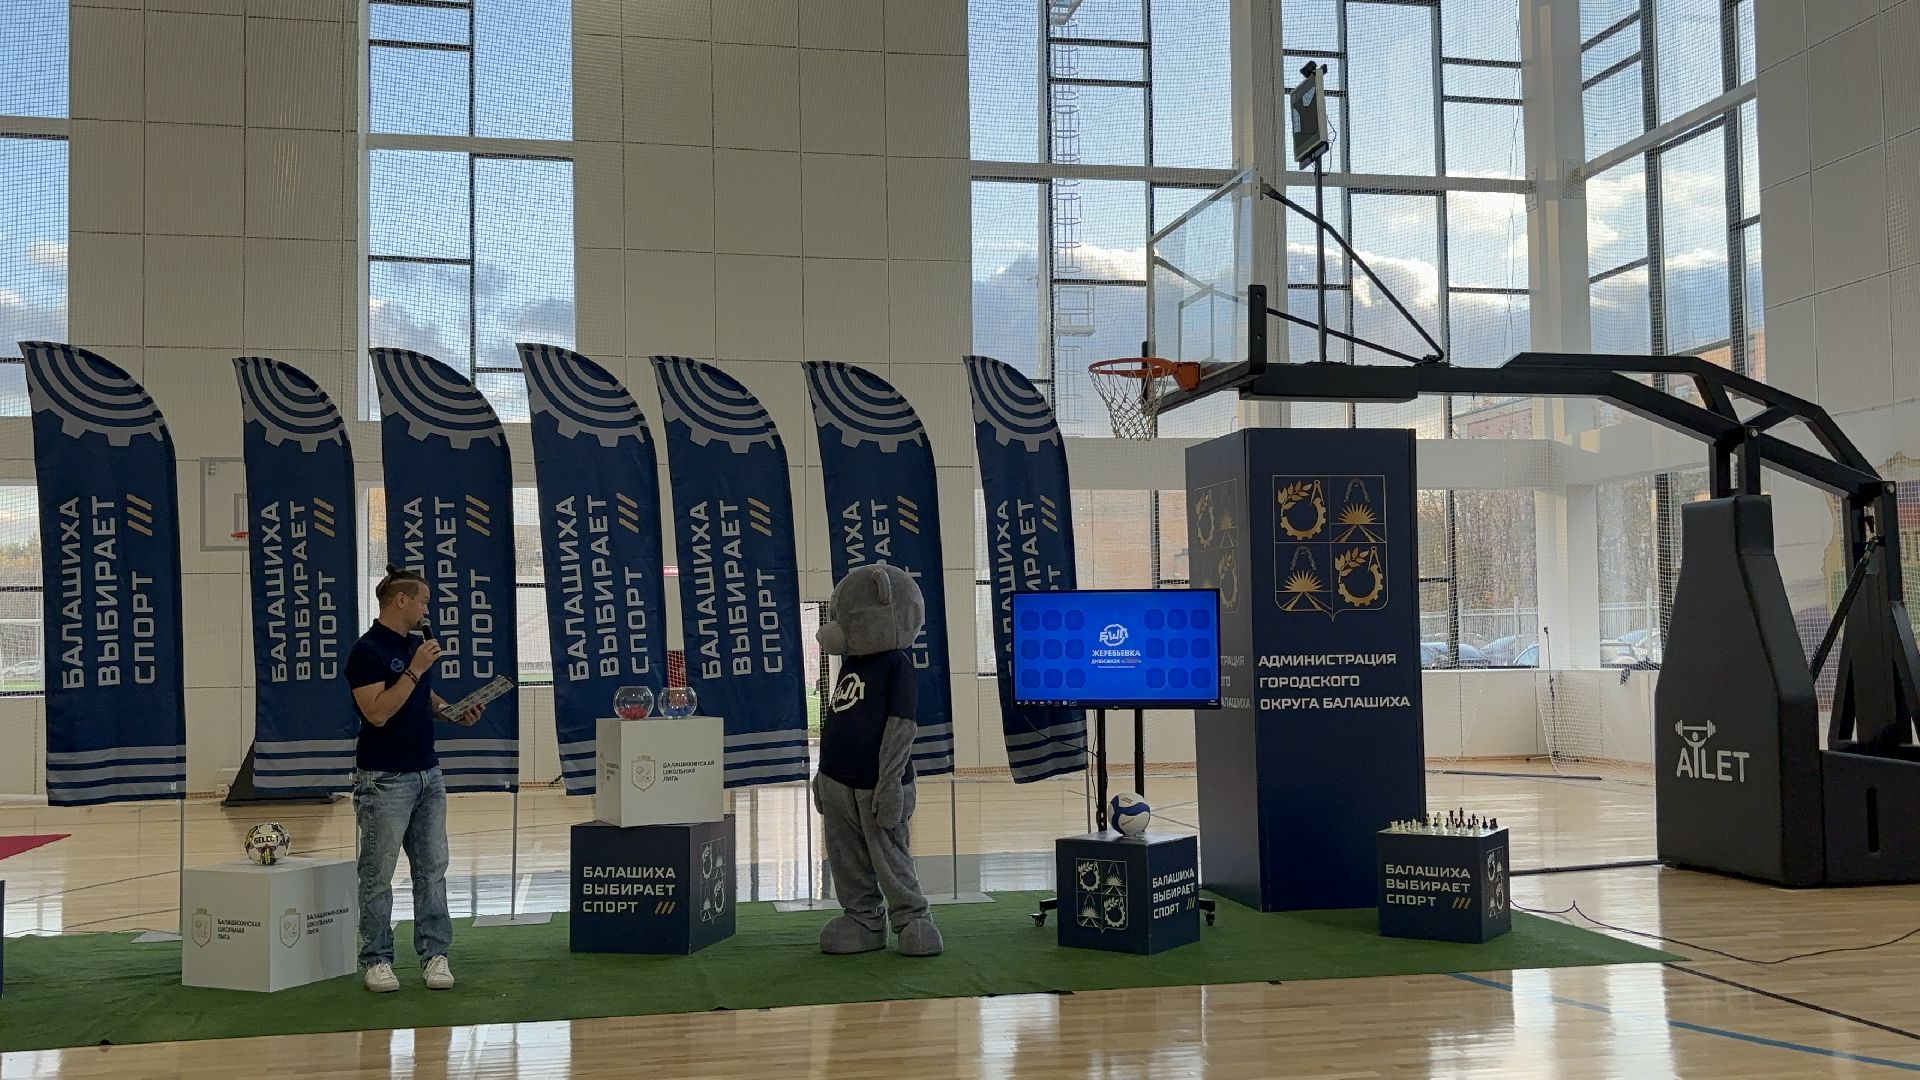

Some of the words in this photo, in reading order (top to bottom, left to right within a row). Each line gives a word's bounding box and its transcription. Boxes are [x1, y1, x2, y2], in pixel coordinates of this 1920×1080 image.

[59, 496, 85, 689] БАЛАШИХА
[91, 495, 121, 686] ВЫБИРАЕТ
[131, 570, 155, 684] СПОРТ
[260, 501, 288, 683] БАЛАШИХА
[289, 500, 311, 681] ВЫБИРАЕТ
[318, 570, 338, 680] СПОРТ
[434, 496, 461, 679] ВЫБИРАЕТ
[470, 568, 494, 679] СПОРТ
[555, 495, 590, 682] БАЛАШИХА
[586, 494, 620, 678] ВЫБИРАЕТ
[624, 566, 650, 674] СПОРТ
[689, 500, 722, 680] БАЛАШИХА
[719, 499, 752, 676] ВЫБИРАЕТ
[756, 568, 783, 674] СПОРТ
[1258, 653, 1397, 668] АДМИНИСТРАЦИЯ
[1259, 675, 1360, 689] ГОРОДСКОГО
[1260, 698, 1320, 711] ОКРУГА
[1323, 696, 1411, 709] БАЛАШИХА
[582, 901, 639, 913] СПОРТ
[583, 866, 676, 879] БАЛАШИХА
[583, 883, 676, 896] ВЫБИРАЕТ
[1152, 867, 1195, 889] БАЛАШИХА
[1153, 882, 1195, 904] ВЫБИРАЕТ
[1153, 902, 1180, 919] СПОРТ
[1385, 863, 1472, 879] БАЛАШИХА
[1385, 878, 1471, 893] ВЫБИРАЕТ
[1386, 893, 1437, 907] СПОРТ
